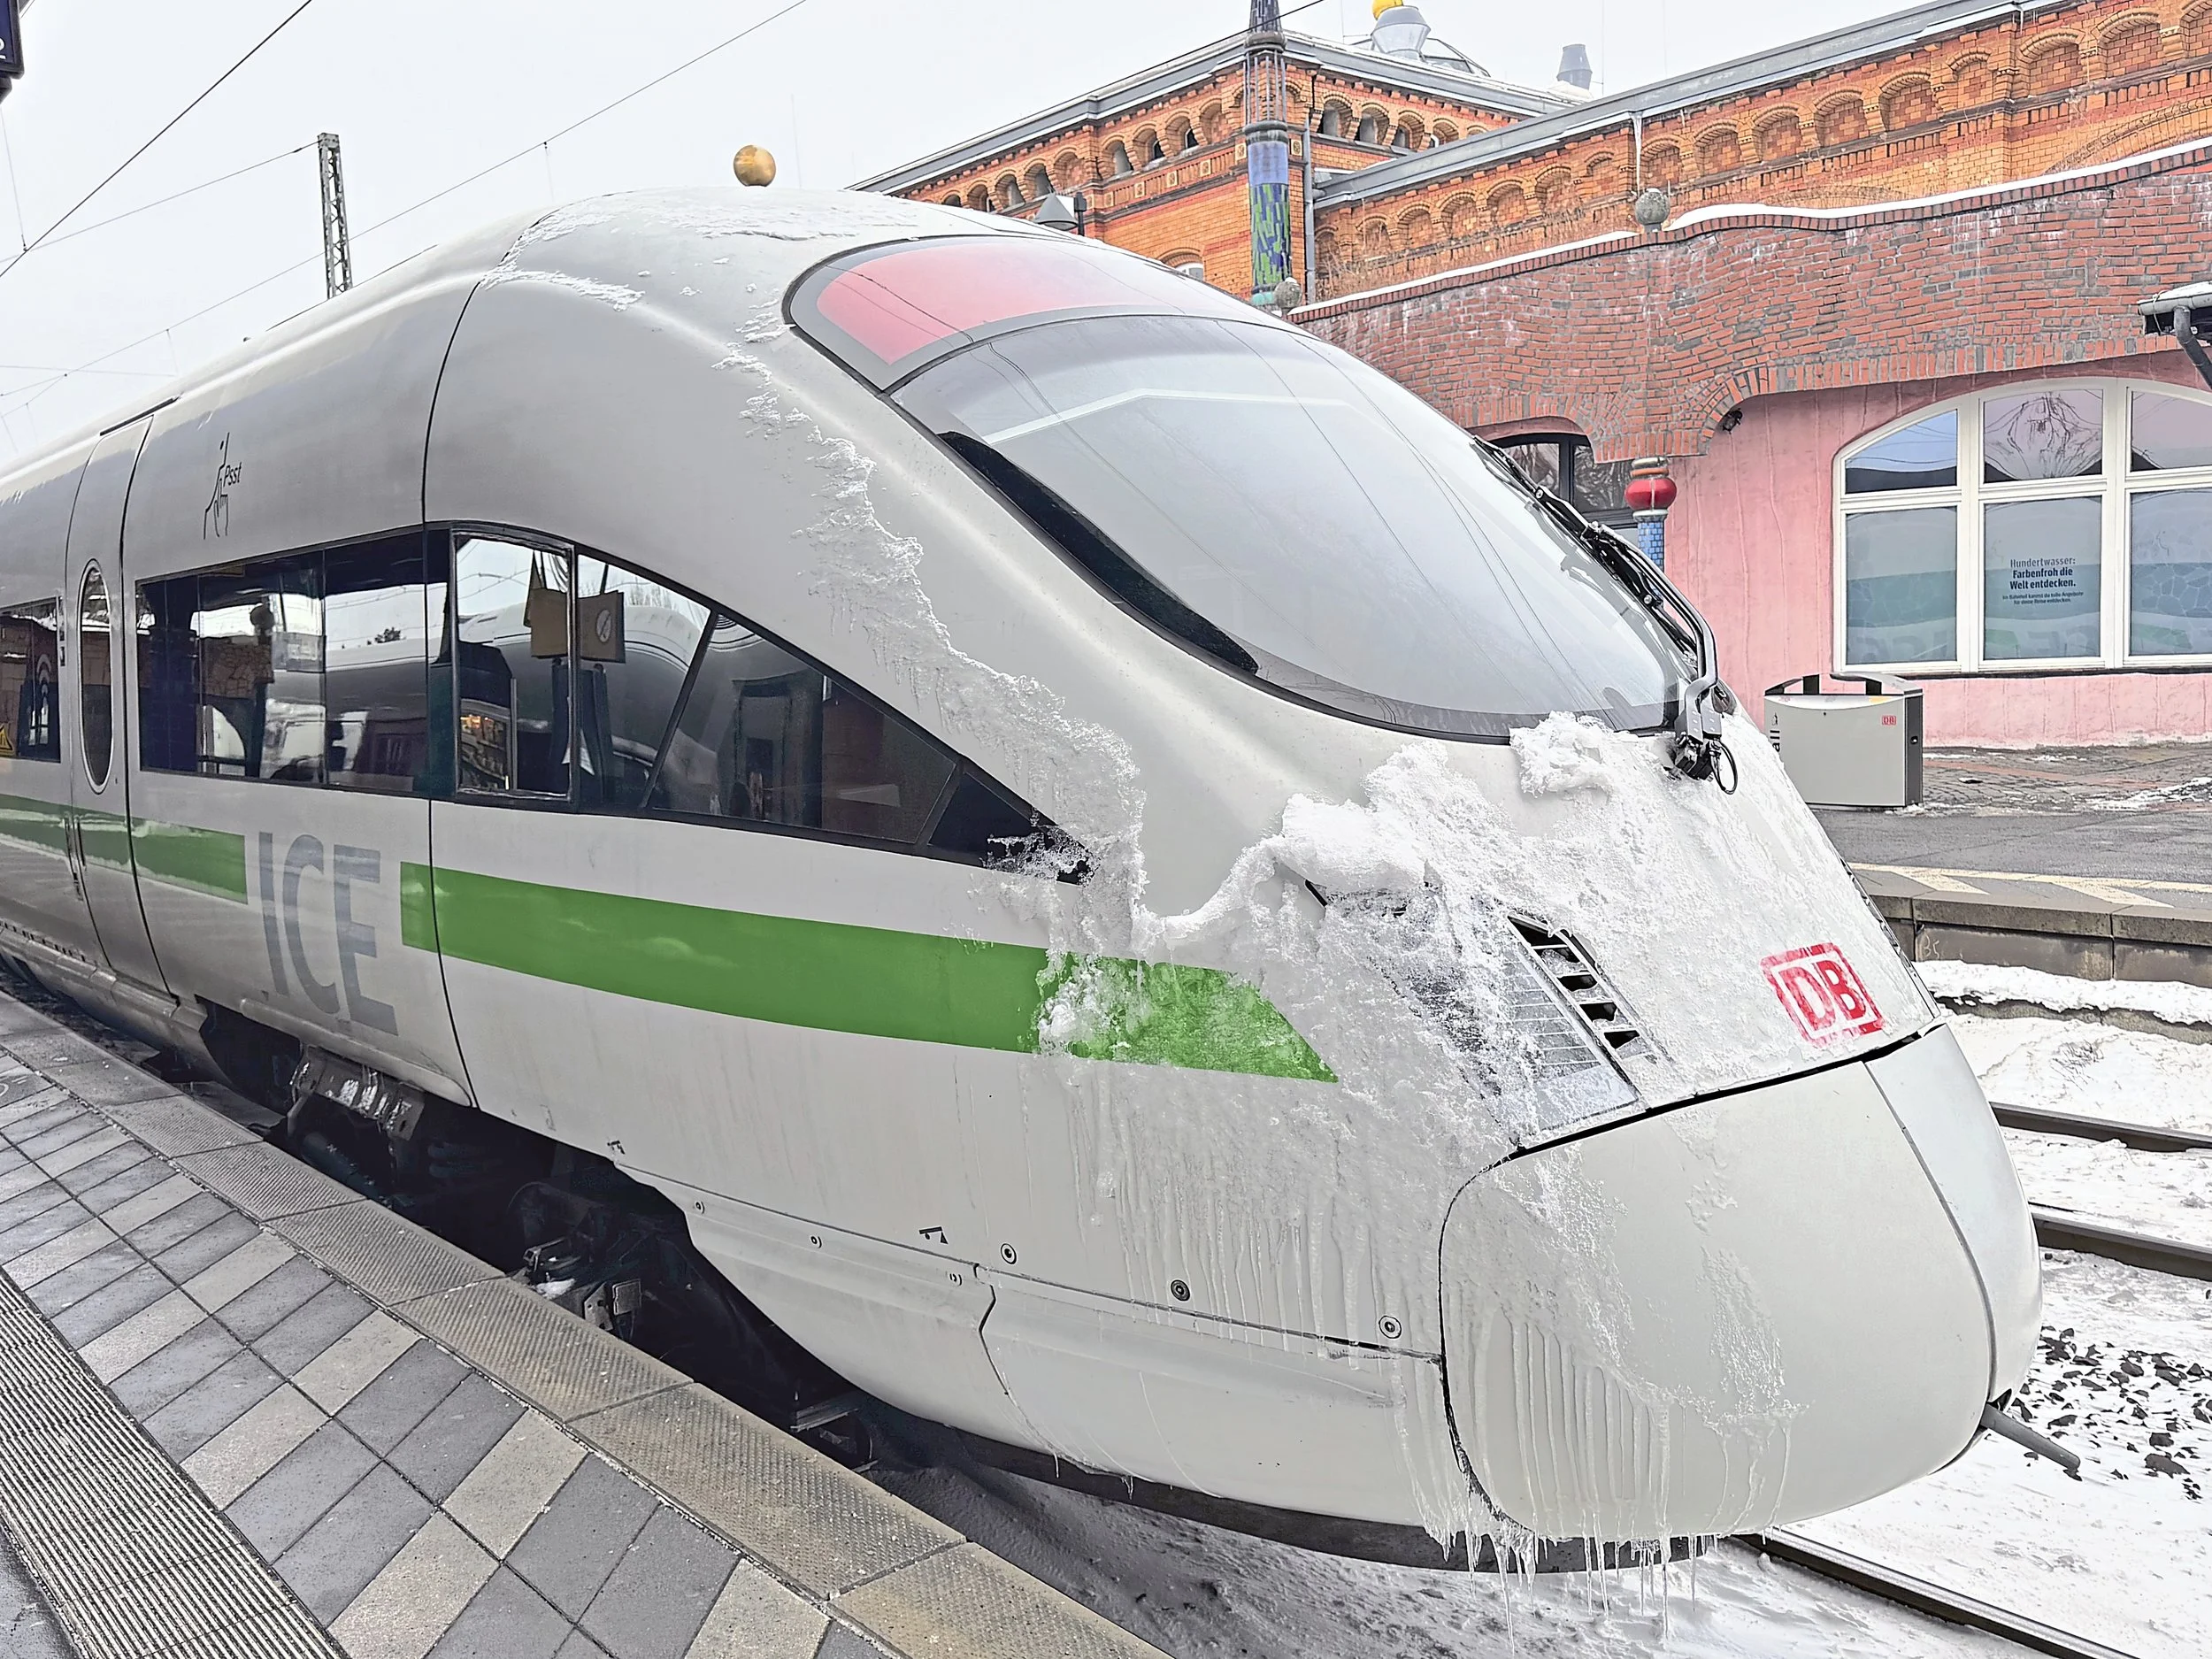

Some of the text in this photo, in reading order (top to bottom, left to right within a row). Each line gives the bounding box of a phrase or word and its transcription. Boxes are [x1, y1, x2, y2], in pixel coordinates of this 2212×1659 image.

[223, 461, 242, 488] Psst
[2010, 557, 2076, 568] Hundertwasser:
[2013, 567, 2073, 579] Farbenfroh die
[2009, 578, 2076, 589] Welt entdecken.
[258, 831, 399, 1036] ICE
[1775, 956, 1870, 1034] DB
